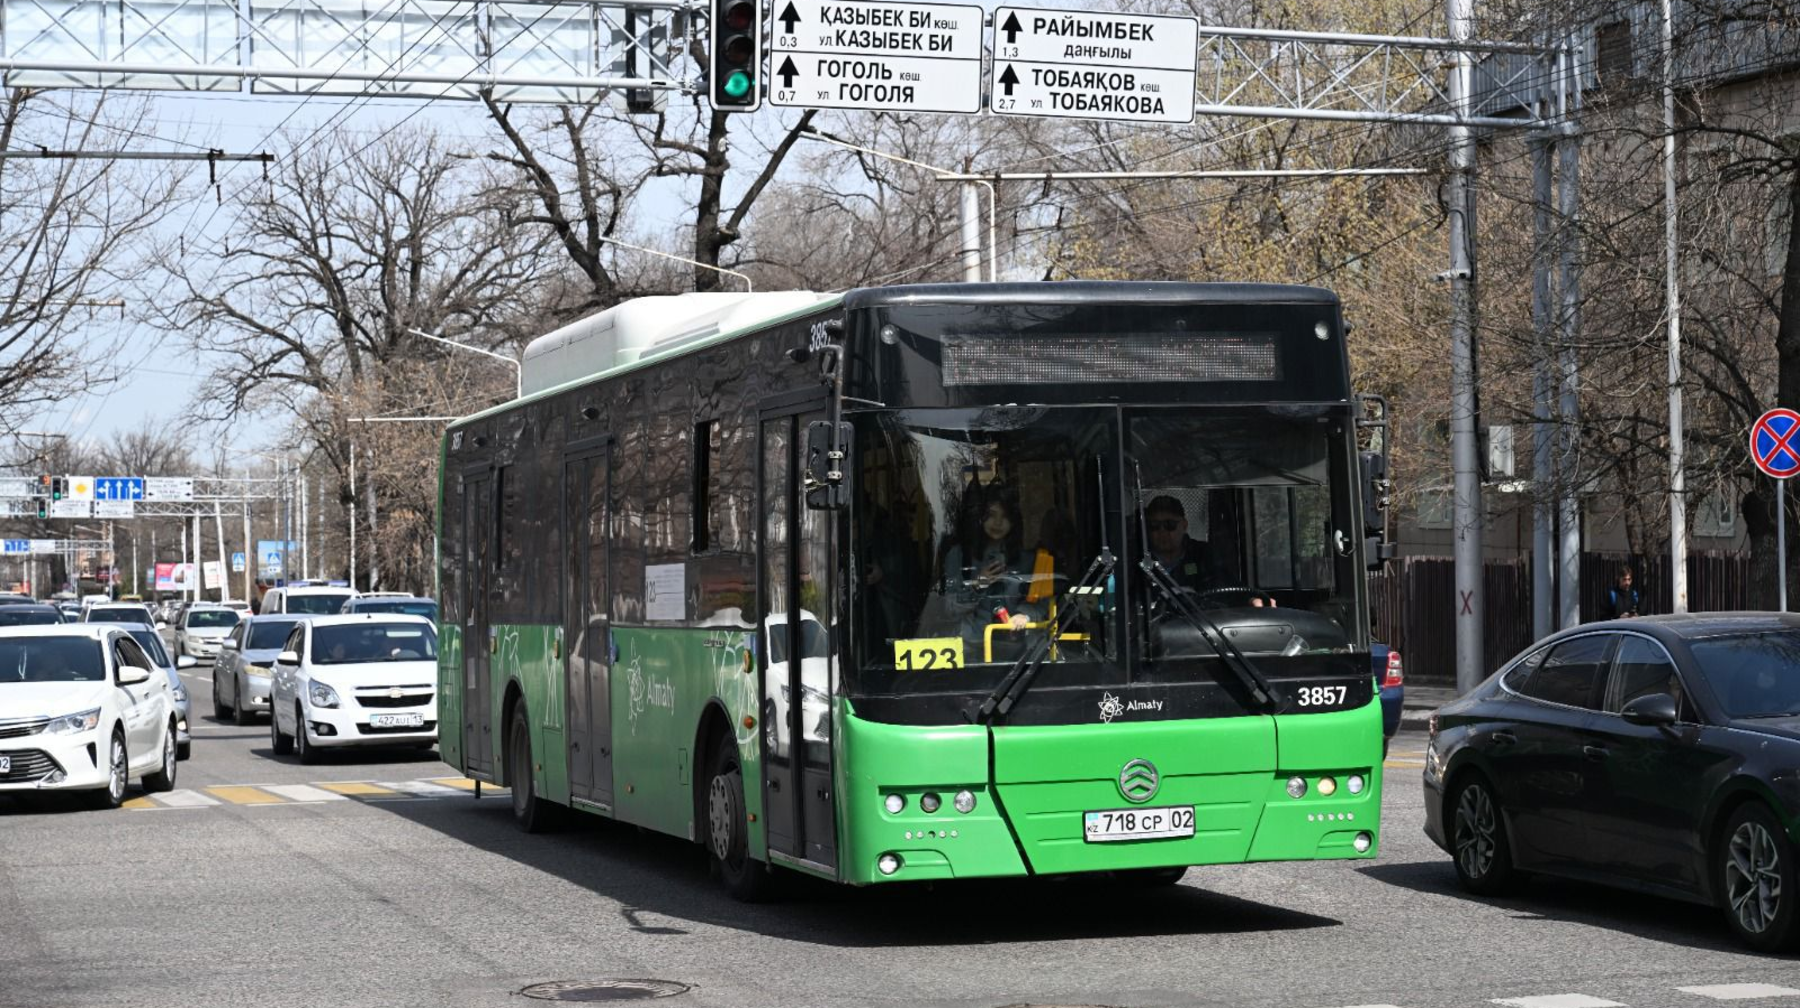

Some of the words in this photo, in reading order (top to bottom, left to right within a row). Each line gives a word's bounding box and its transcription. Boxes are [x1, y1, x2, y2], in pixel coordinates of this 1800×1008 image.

[820, 6, 904, 27] ҚАЗЫБЕК
[909, 10, 931, 29] БИ
[1033, 15, 1154, 42] РАЙЫМБЕК
[780, 36, 798, 48] 0,3
[835, 29, 923, 50] КАЗЫБЕК
[928, 34, 953, 52] БИ
[1002, 46, 1019, 59] 1,3
[1064, 44, 1132, 60] даңғылы
[817, 59, 893, 80] ГОГОЛЬ
[1031, 68, 1136, 92] ТОБАЯҚОВ
[778, 90, 796, 103] 0,7
[839, 83, 915, 103] ГОГОЛЯ
[1049, 91, 1166, 115] ТОБАЯКОВА
[998, 98, 1016, 112] 2,7
[899, 647, 958, 671] 123
[647, 673, 676, 716] Almaty
[1297, 686, 1348, 706] 3857
[1126, 698, 1164, 712] Almaty
[1087, 825, 1099, 833] KZ
[1102, 812, 1136, 832] 718
[1141, 815, 1163, 830] CP
[1171, 810, 1194, 828] 02
